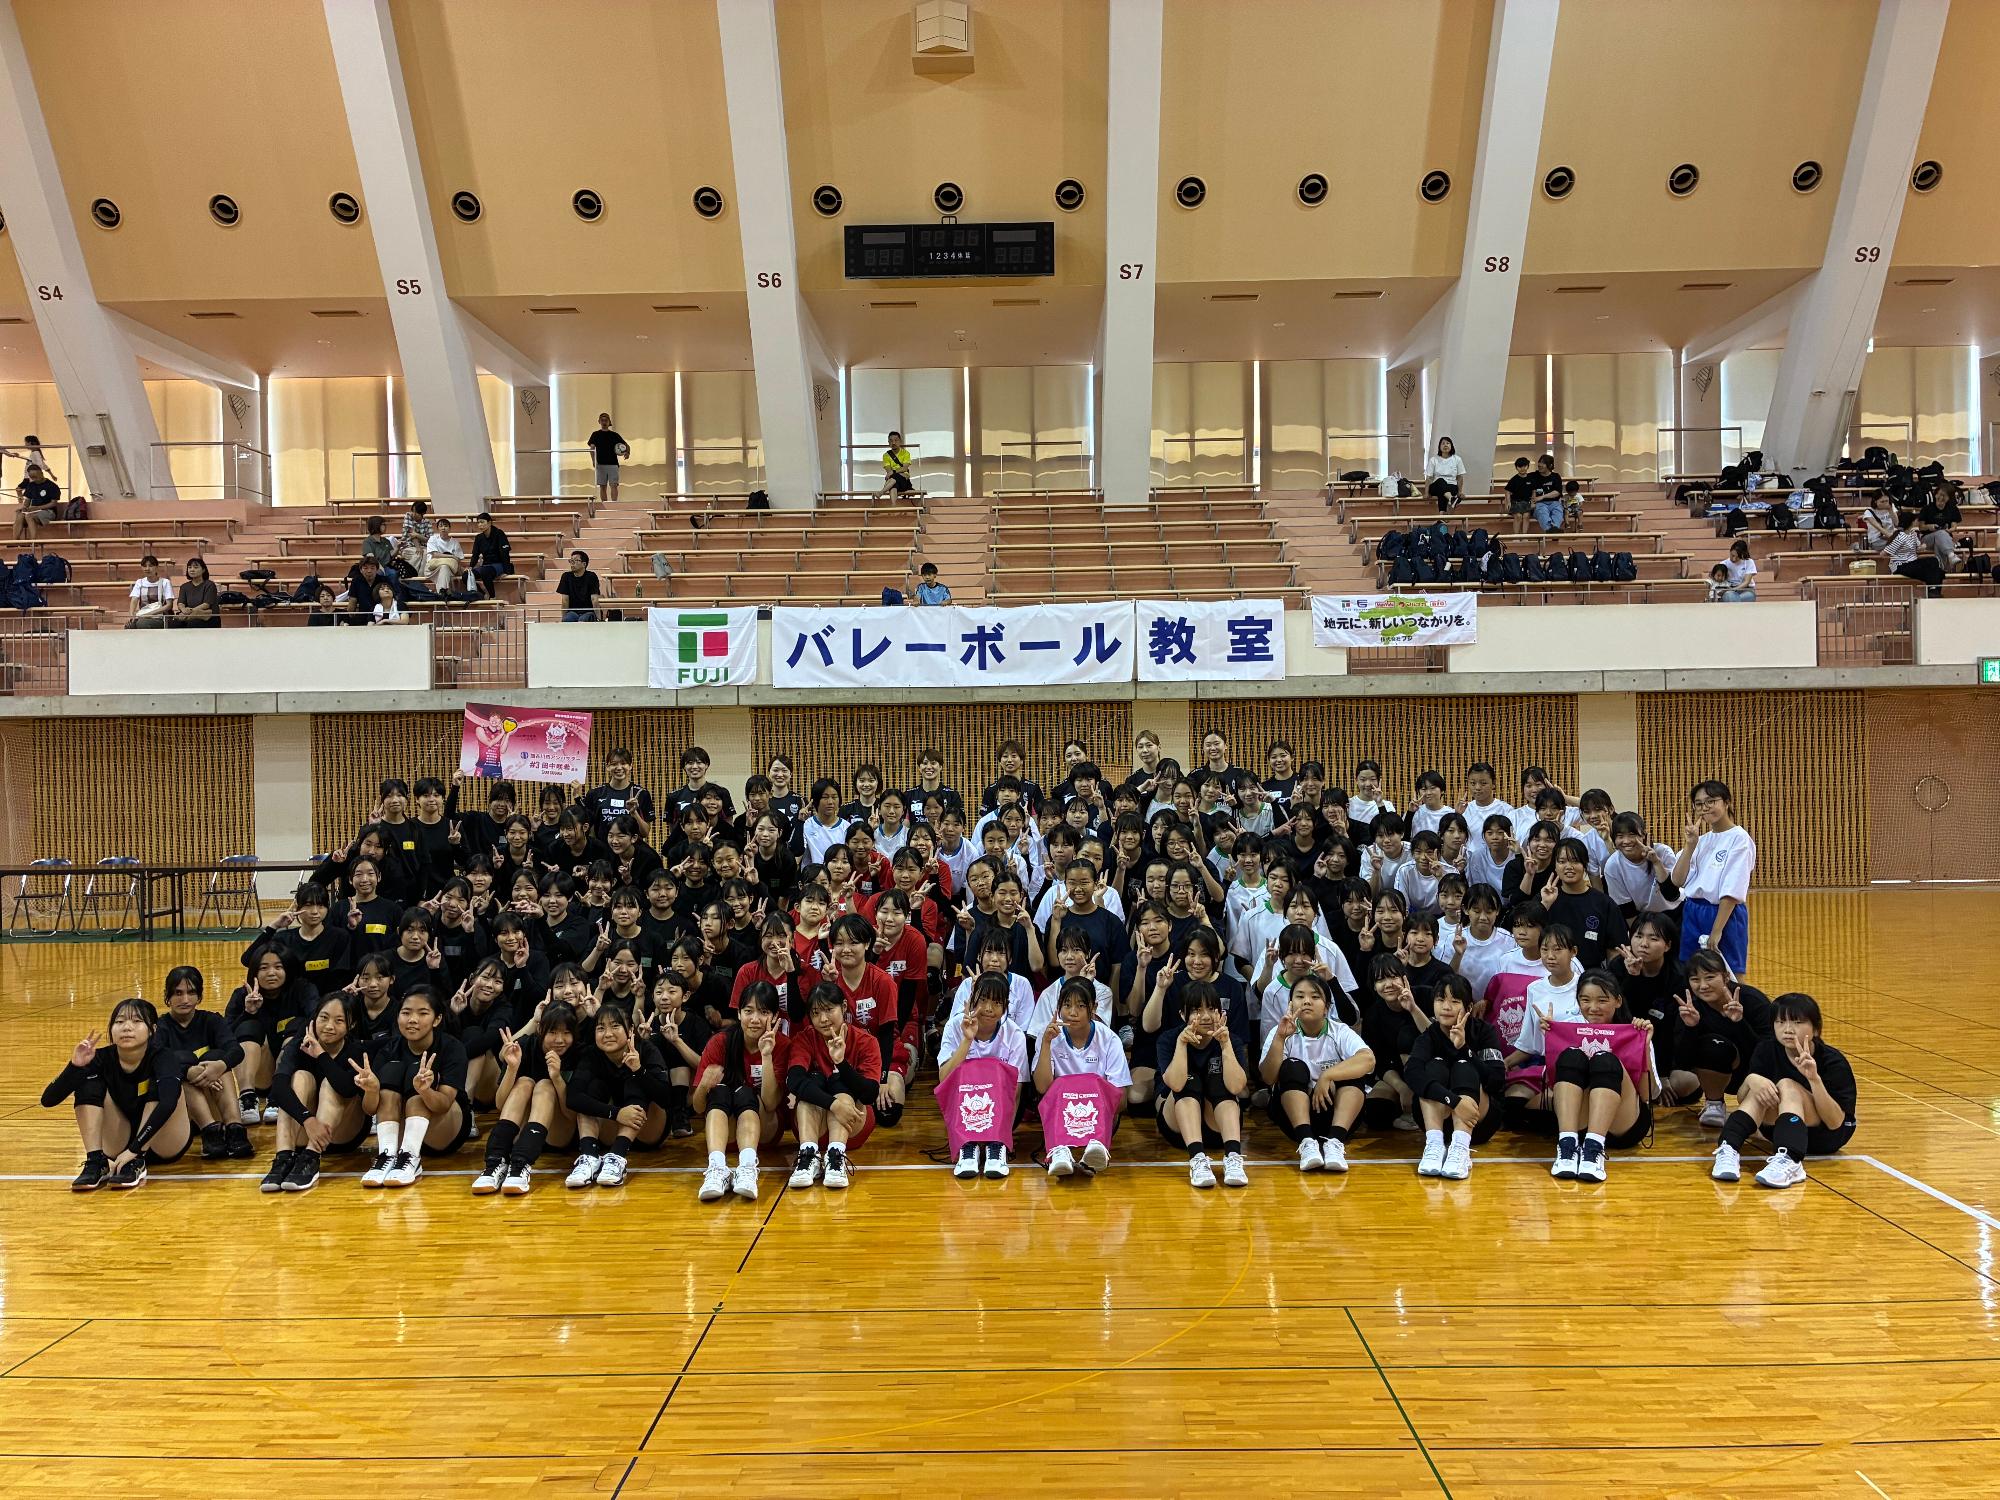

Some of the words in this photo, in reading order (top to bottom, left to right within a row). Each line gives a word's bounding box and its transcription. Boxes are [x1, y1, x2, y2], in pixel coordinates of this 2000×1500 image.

[1854, 246, 1880, 262] S9
[1119, 264, 1143, 279] S7
[1484, 256, 1510, 272] S8
[396, 279, 421, 294] S5
[757, 272, 782, 288] S6
[38, 285, 63, 300] S4
[1323, 614, 1470, 630] 地元に、新しいつながりを。
[786, 622, 1122, 670] バレーボール
[1149, 615, 1274, 664] 教室
[677, 667, 729, 684] FUJI
